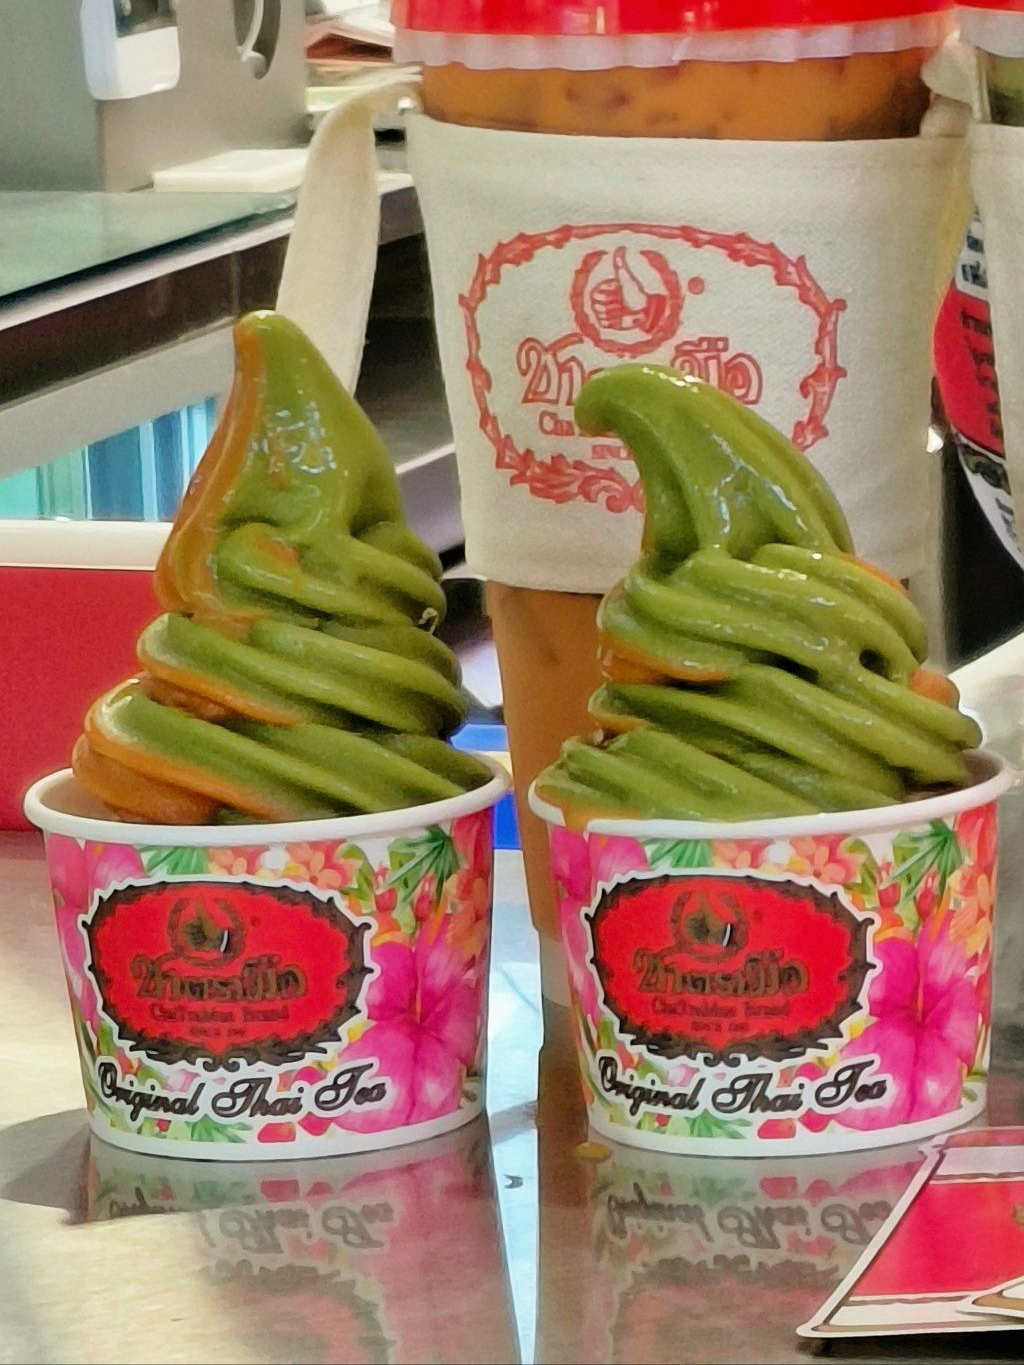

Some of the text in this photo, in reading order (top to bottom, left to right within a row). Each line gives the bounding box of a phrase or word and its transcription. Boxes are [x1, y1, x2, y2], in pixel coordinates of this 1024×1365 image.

[98, 1061, 387, 1121] Original Thai Tea
[598, 1056, 887, 1116] Original Thai Tea
